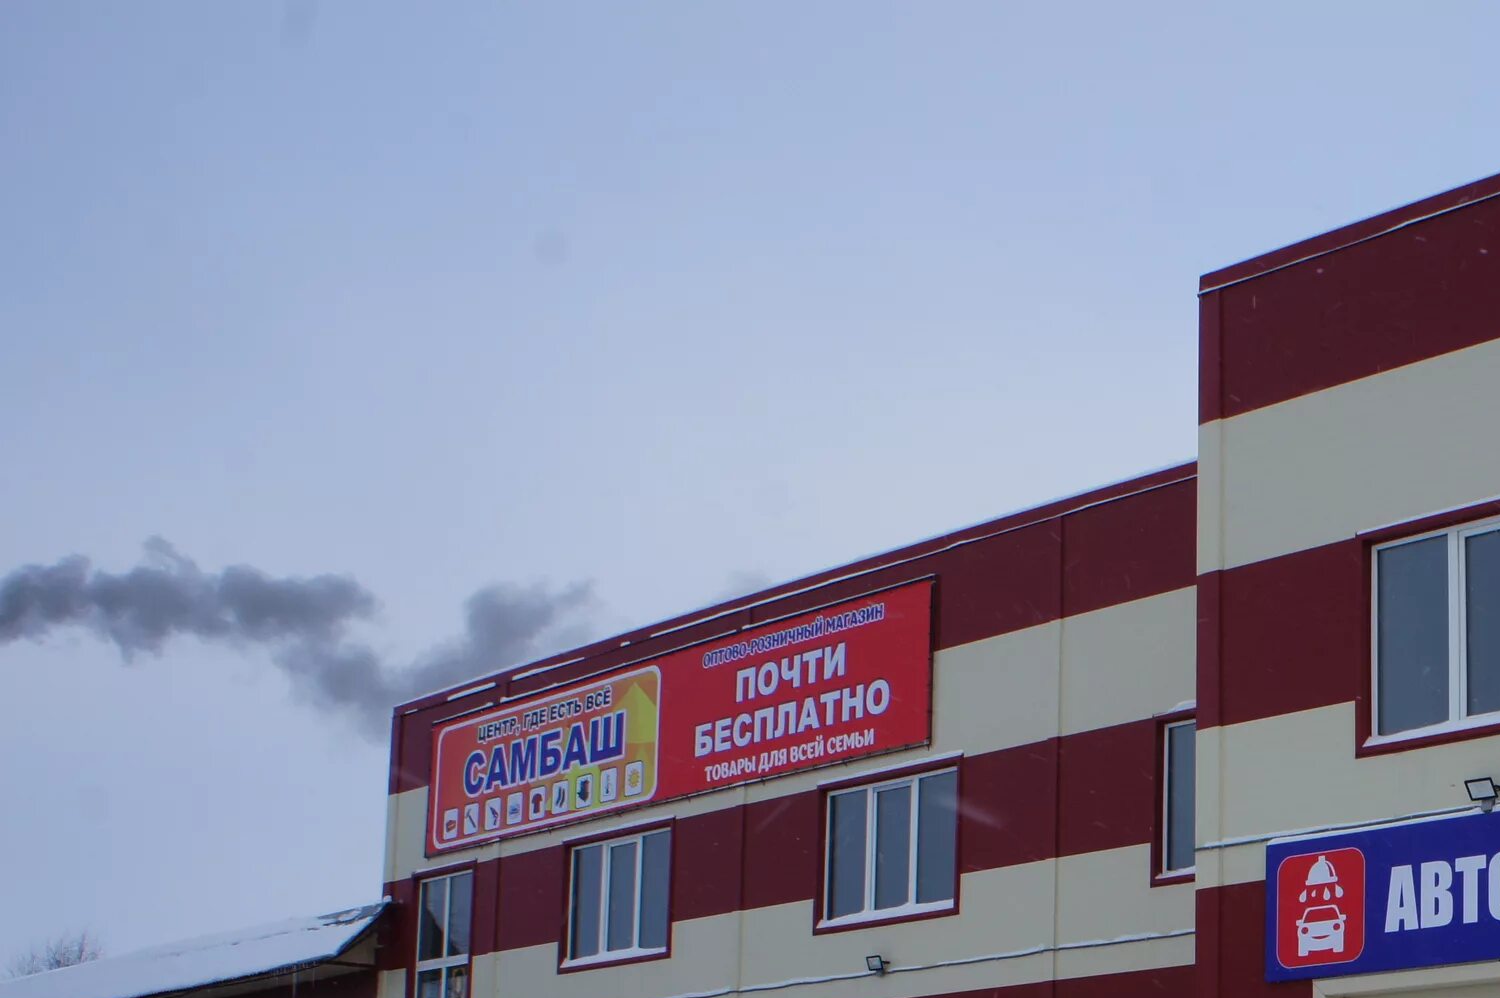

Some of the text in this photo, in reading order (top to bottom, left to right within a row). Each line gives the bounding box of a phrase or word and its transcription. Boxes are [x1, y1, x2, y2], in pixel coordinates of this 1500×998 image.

[702, 602, 885, 669] ОПТОВО-РОЗНИЧНЫЙ МАГАЗИН
[735, 642, 847, 703] ПОЧТИ
[522, 708, 547, 732] ГДЕ
[549, 698, 583, 722] ЕСТЬ
[585, 685, 612, 712] ВСЁ
[694, 679, 890, 758] БЕСПЛАТНО
[464, 710, 626, 797] САМБАШ
[704, 728, 875, 782] ТОВАРЫ ДЛЯ ВСЕЙ СЕМЬИ
